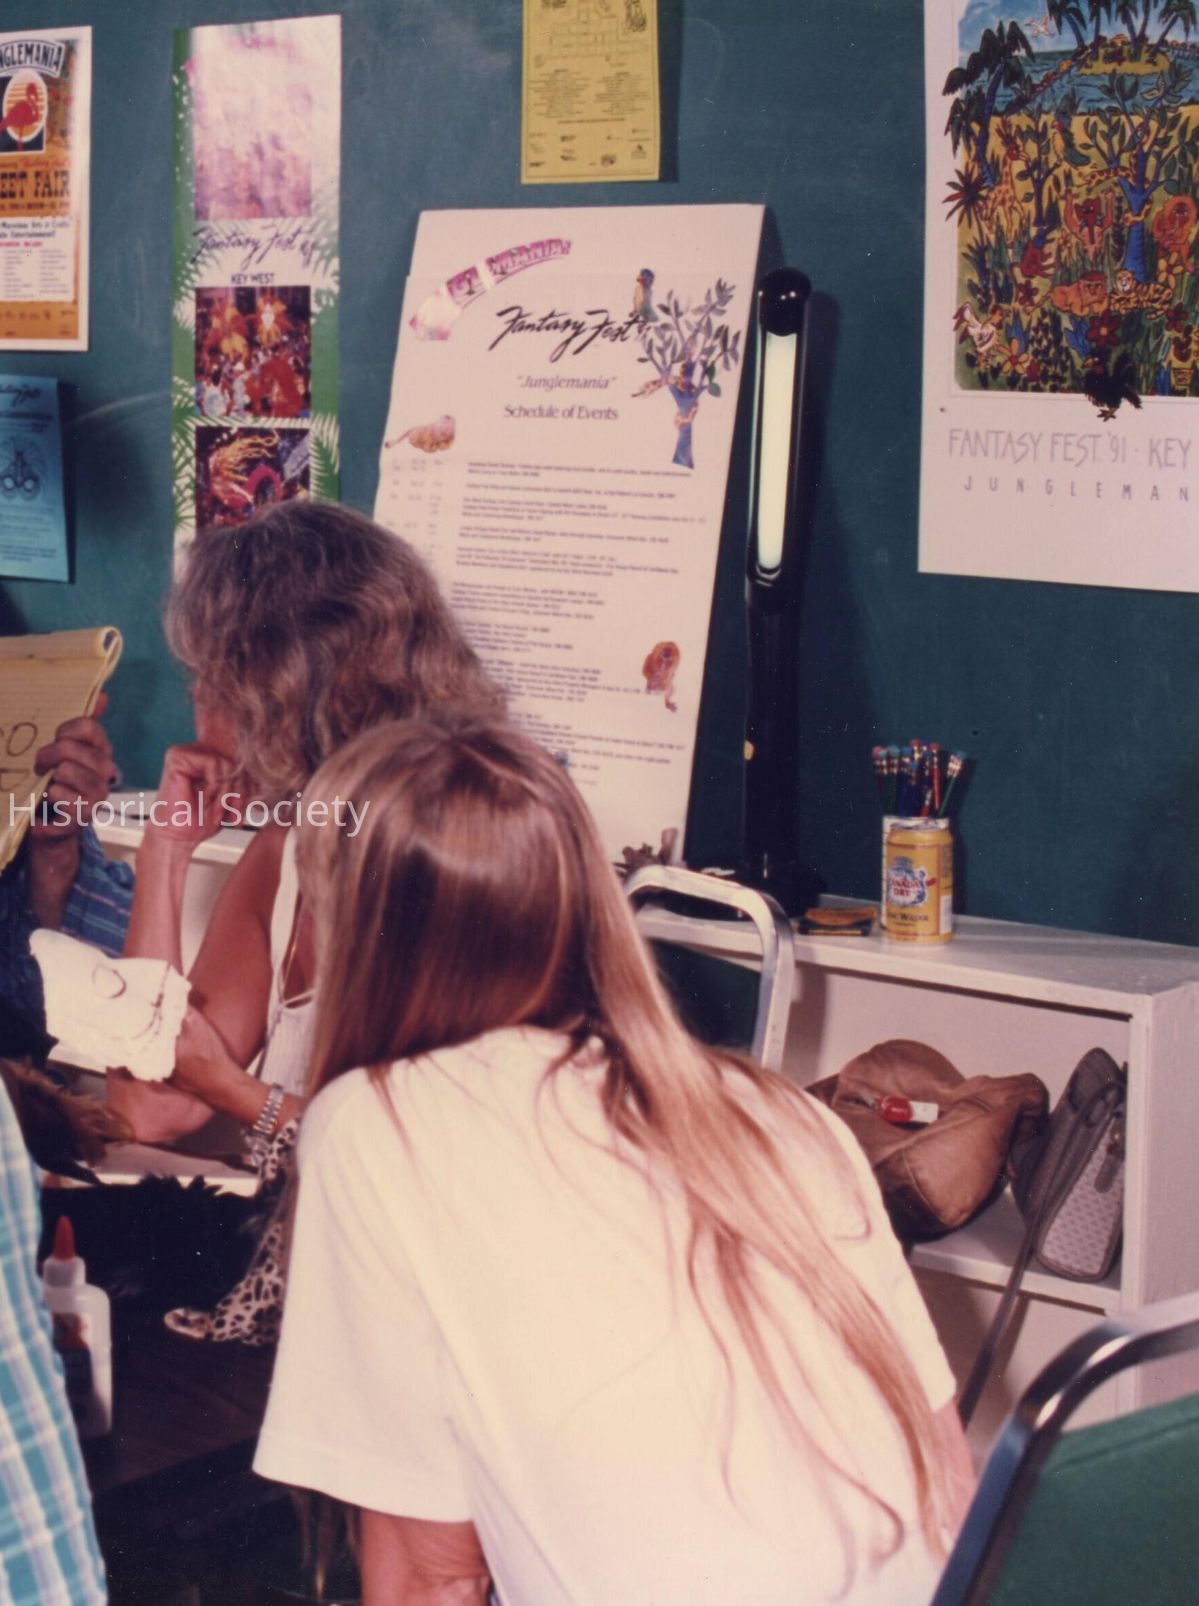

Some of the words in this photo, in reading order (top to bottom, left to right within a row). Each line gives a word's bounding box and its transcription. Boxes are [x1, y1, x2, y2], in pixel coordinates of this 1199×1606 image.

[33, 170, 70, 197] FAIR
[231, 275, 248, 285] KEY
[251, 273, 274, 284] WEST
[487, 304, 588, 364] Fantasy
[570, 309, 648, 356] Fest
[504, 404, 559, 420] Schedule
[562, 404, 576, 419] of
[577, 406, 619, 421] Events
[950, 429, 1043, 464] FANTASY
[1050, 432, 1102, 468] FEST
[1150, 437, 1192, 471] KEY
